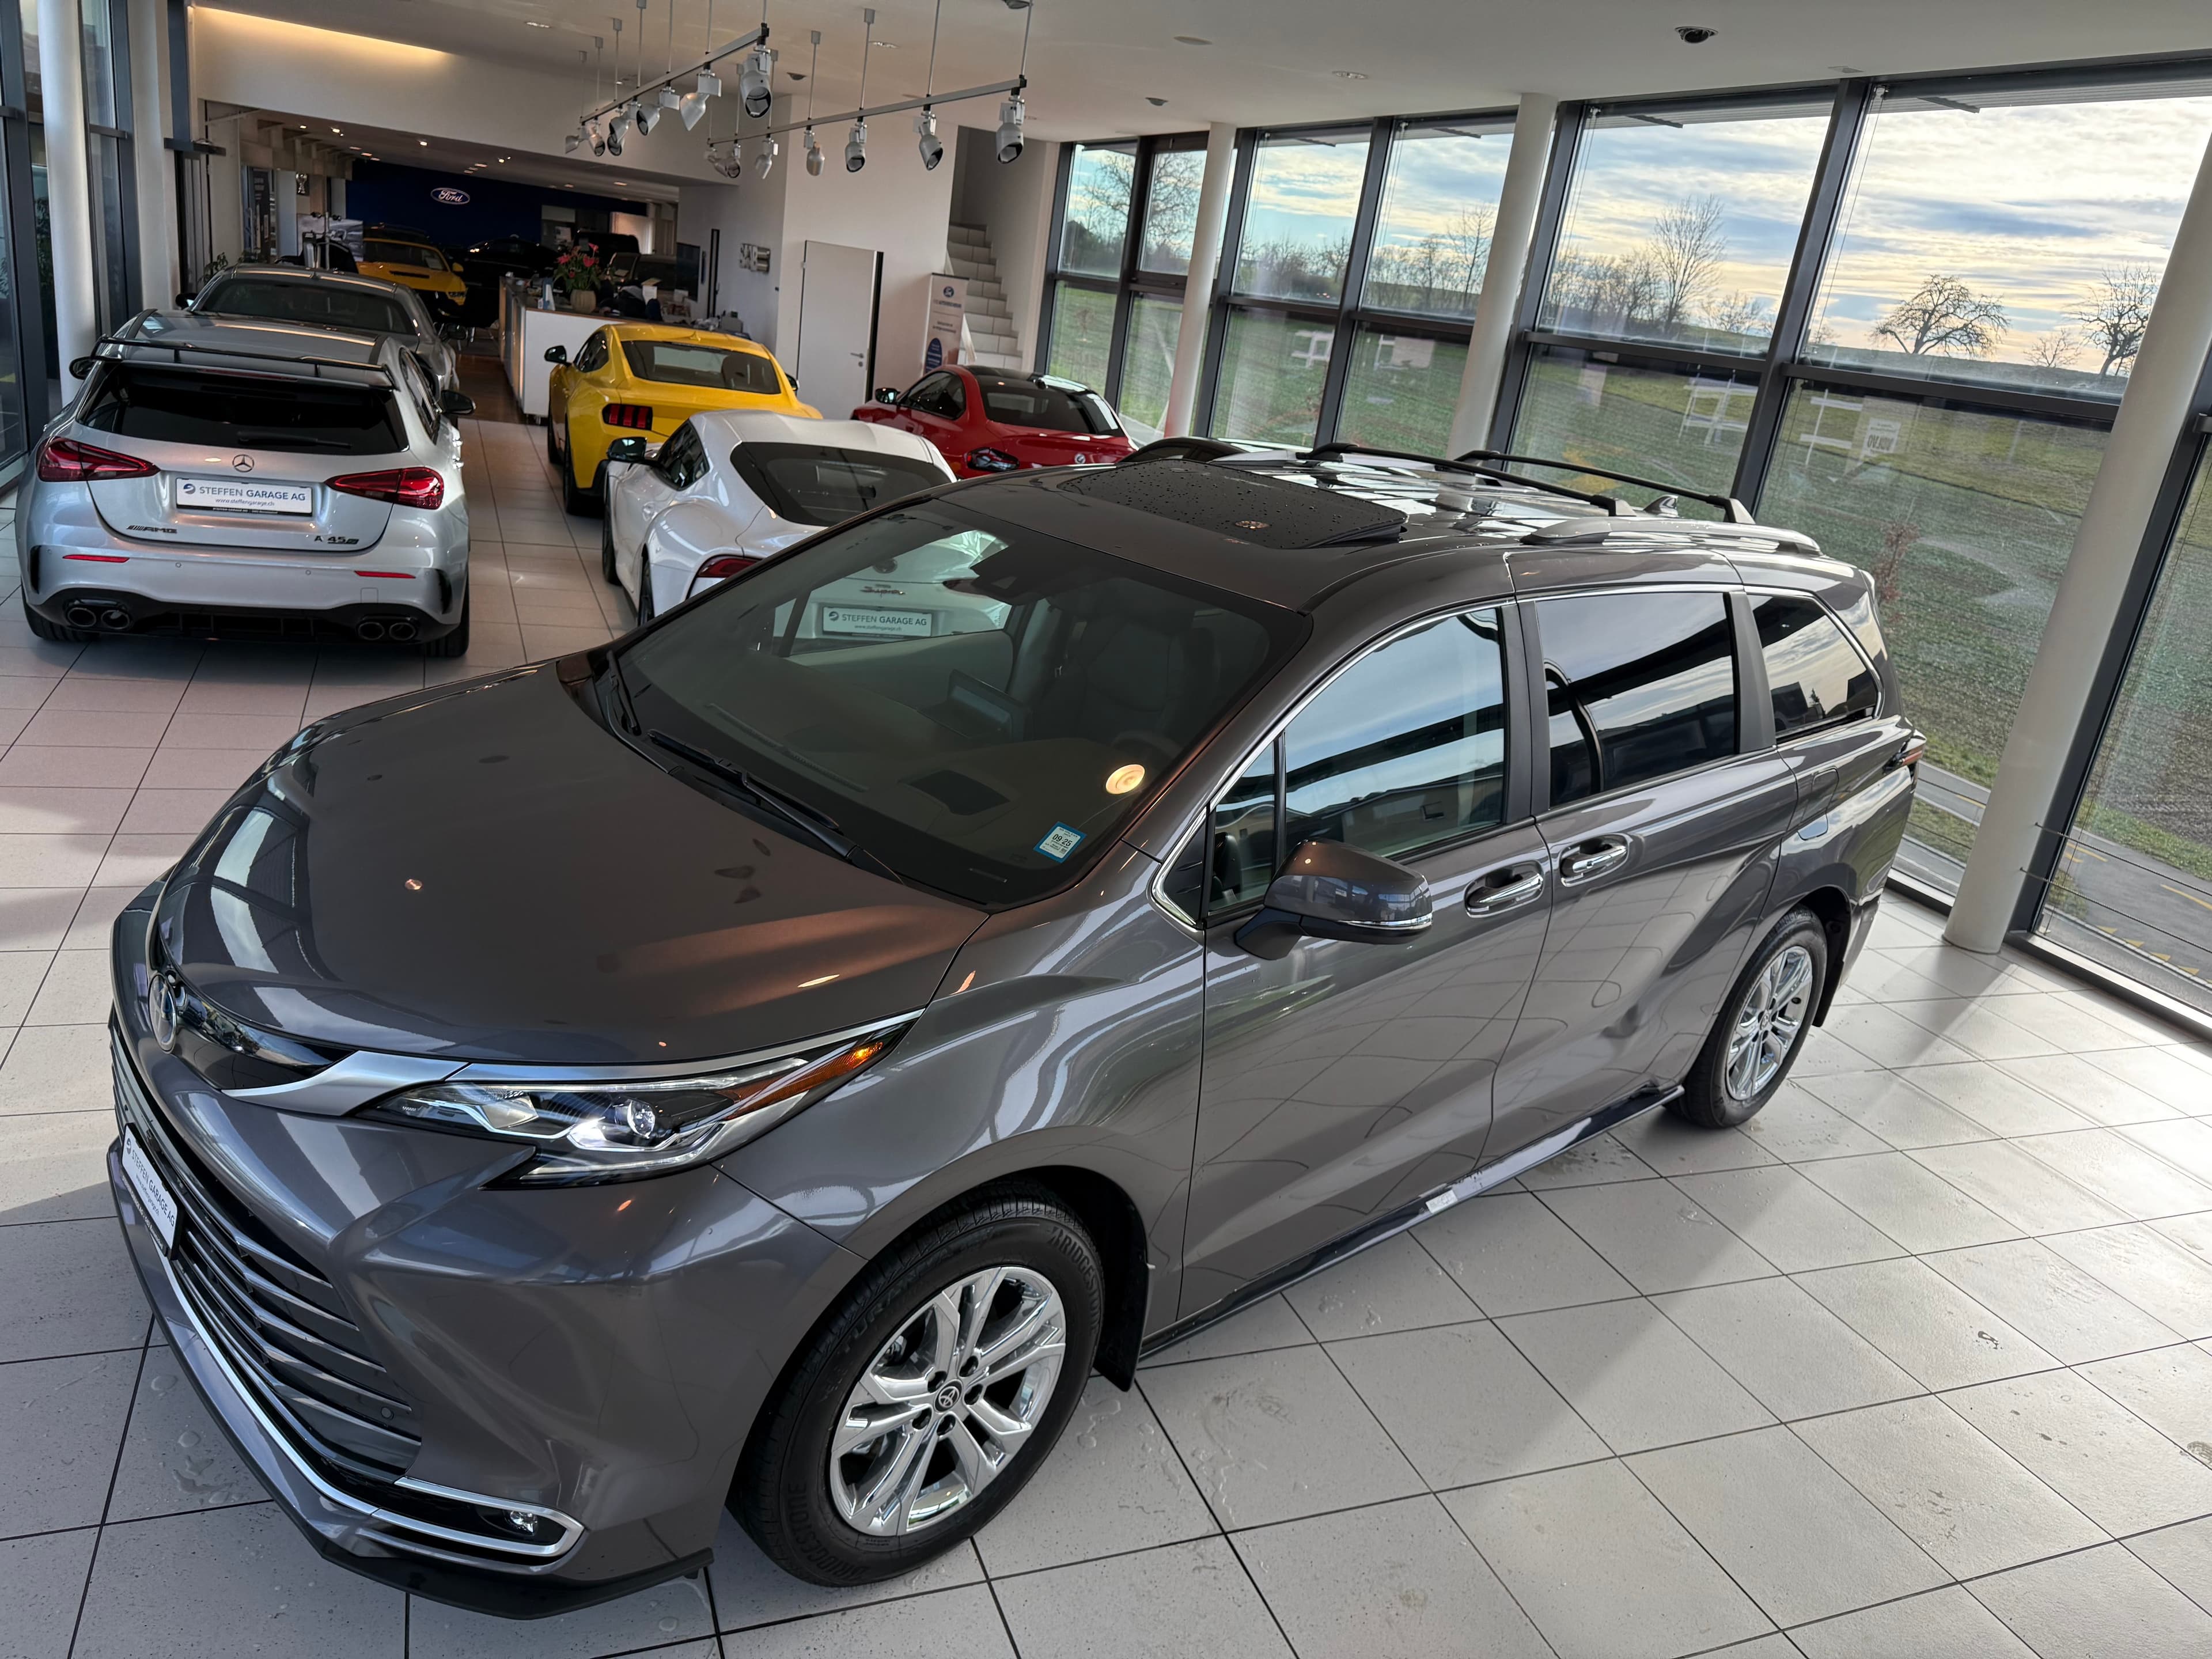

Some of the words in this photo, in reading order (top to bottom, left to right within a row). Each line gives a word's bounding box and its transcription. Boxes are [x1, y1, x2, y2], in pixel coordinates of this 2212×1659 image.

[438, 190, 463, 202] Ford
[199, 486, 243, 496] STEFFEN
[246, 490, 288, 499] GARAGE
[290, 493, 306, 501] AG
[215, 498, 275, 507] www.steffengarage.ch
[842, 614, 877, 622] STEFFEN
[879, 616, 913, 625] GARAGE
[131, 1150, 149, 1184] STEFFEN
[149, 1179, 168, 1215] GARAGE
[167, 1210, 175, 1227] AG
[1047, 1226, 1100, 1335] BRIDGESTONE
[787, 1483, 869, 1580] BRIDGESTONE
